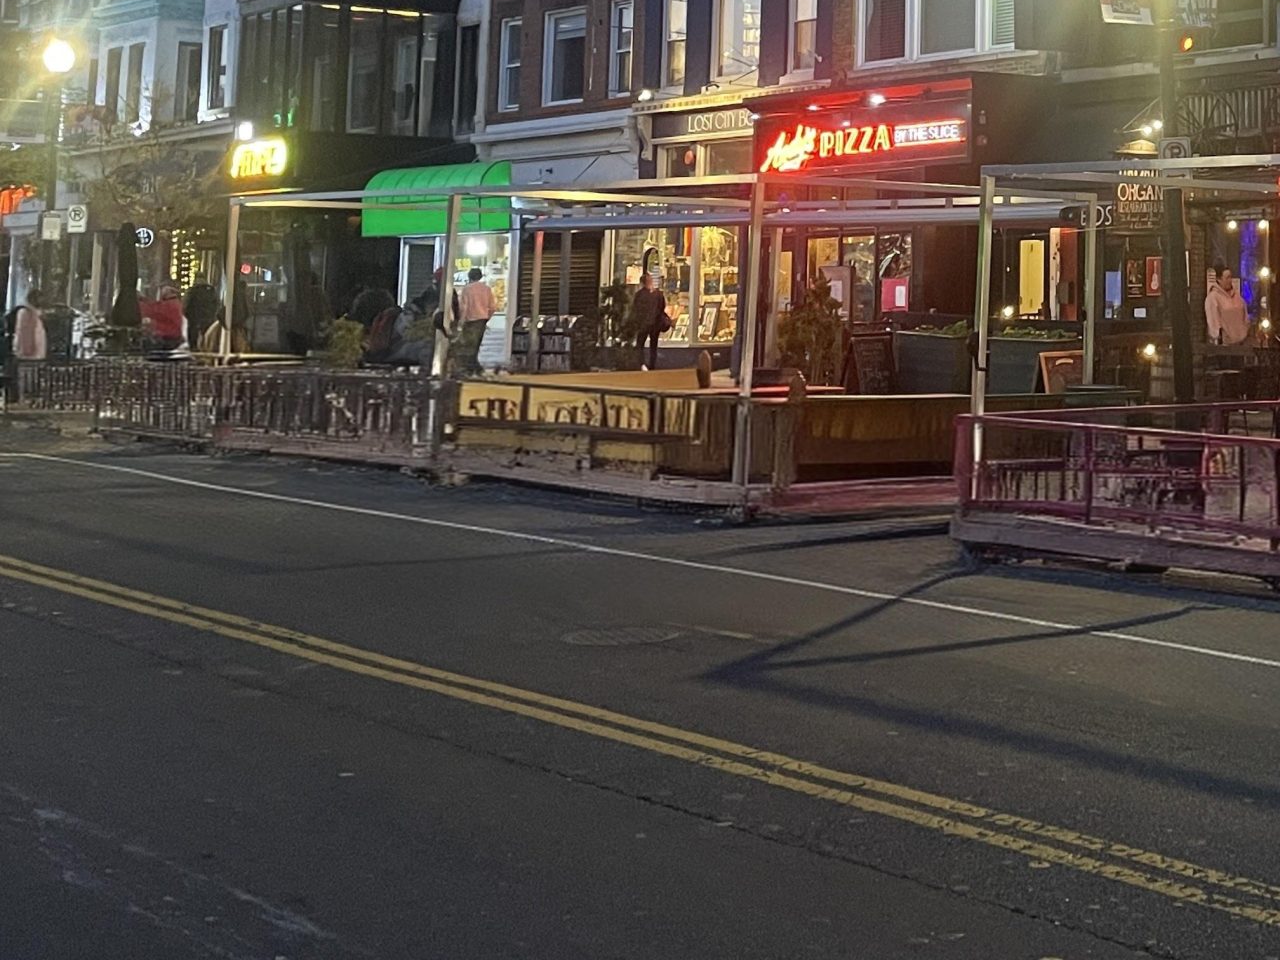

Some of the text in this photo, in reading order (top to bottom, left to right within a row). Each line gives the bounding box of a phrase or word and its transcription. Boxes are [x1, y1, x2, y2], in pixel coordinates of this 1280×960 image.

[688, 114, 713, 133] LOST
[715, 111, 735, 130] CITY
[819, 124, 892, 158] PIZZA
[894, 129, 907, 143] BY
[908, 127, 928, 141] THE
[928, 125, 960, 140] SLICE
[1117, 183, 1164, 201] ORGAN
